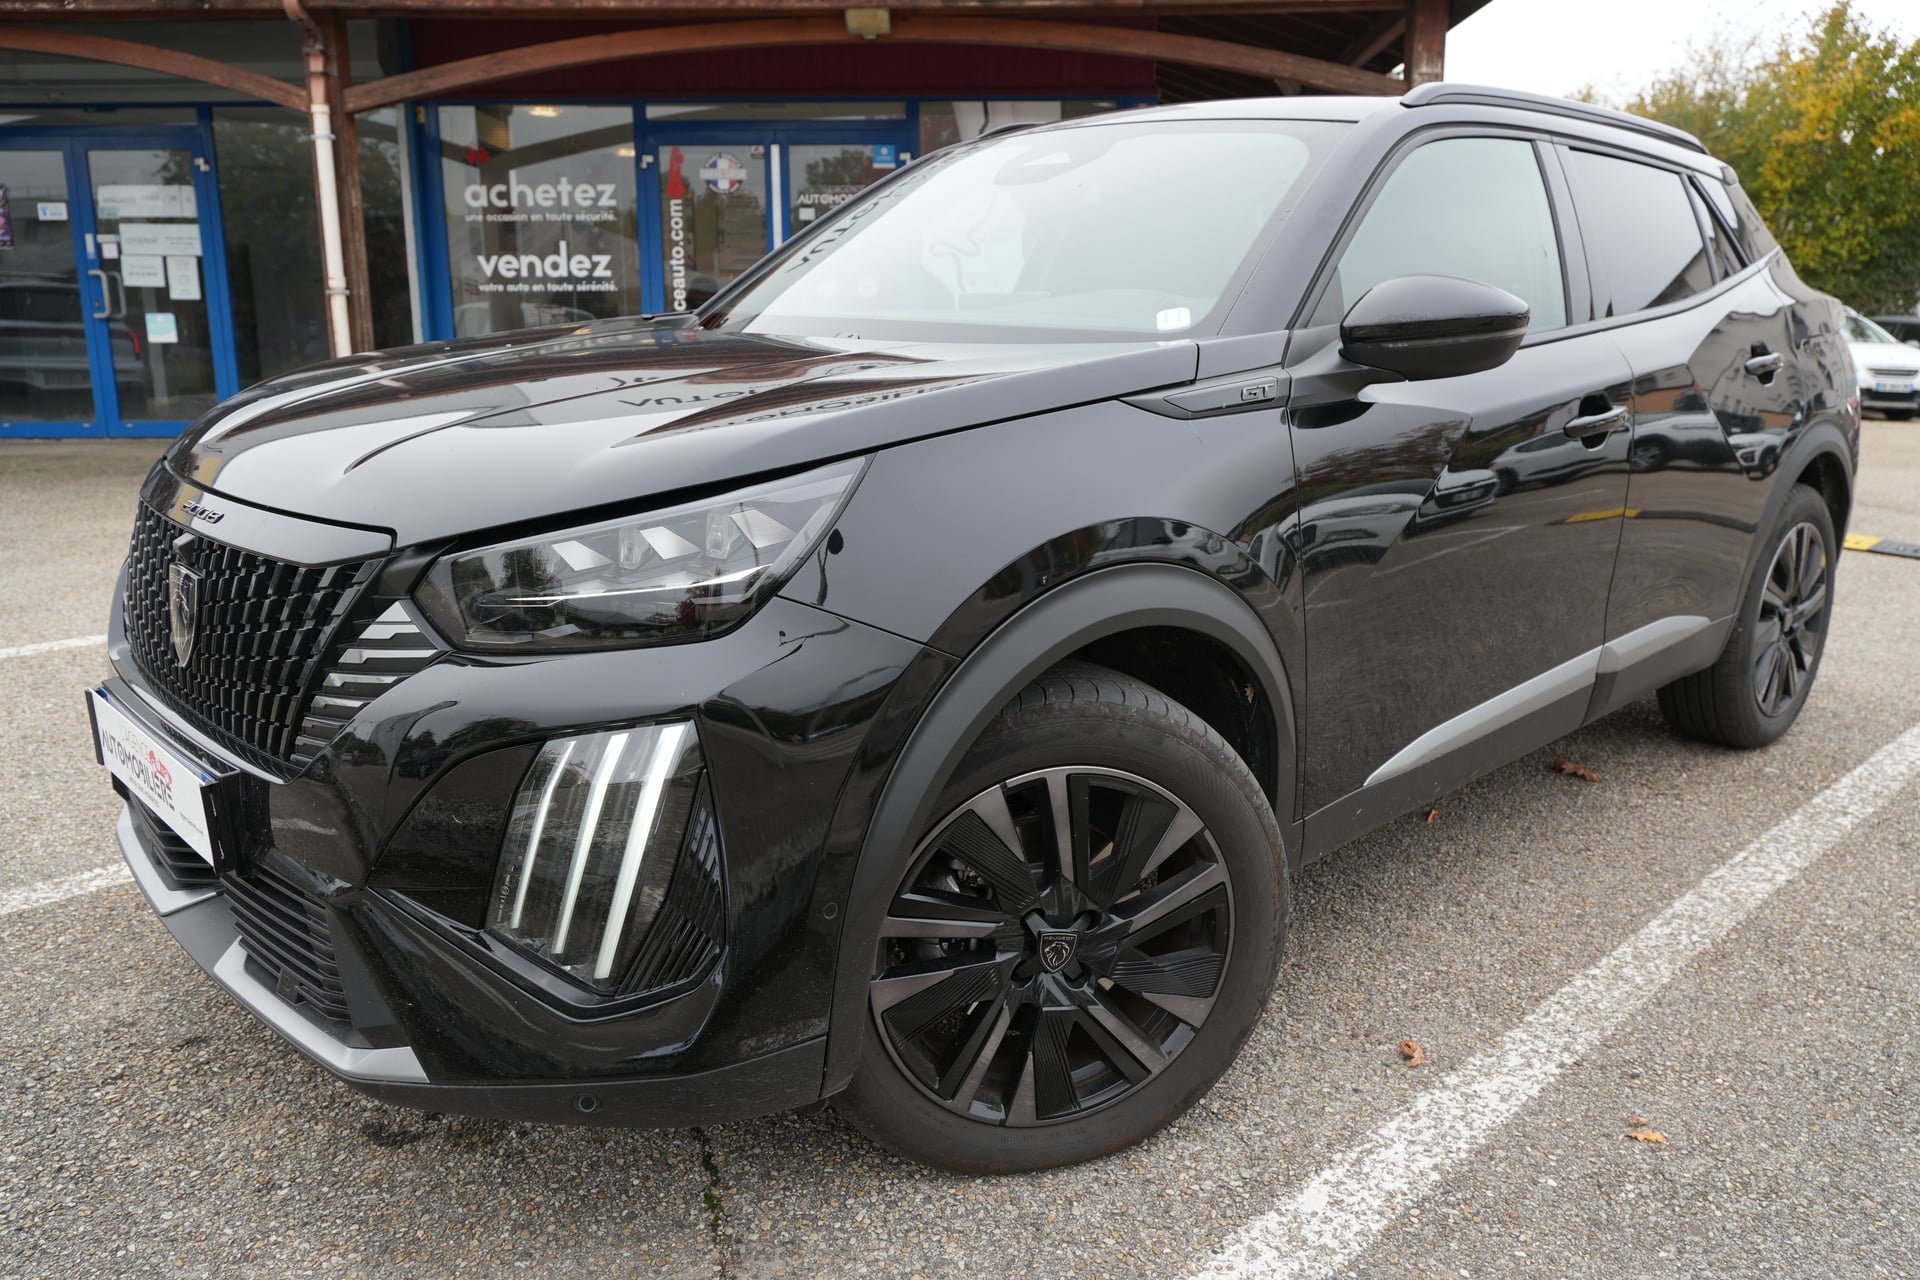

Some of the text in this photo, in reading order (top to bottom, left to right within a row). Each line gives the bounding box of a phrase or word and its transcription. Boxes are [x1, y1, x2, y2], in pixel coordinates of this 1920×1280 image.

[464, 169, 617, 208] achetez
[465, 209, 617, 222] une occasion en toute sécurité.
[477, 239, 612, 279] vendez
[478, 280, 618, 292] votre auto en toute sérénité.
[1241, 383, 1274, 401] GT
[181, 500, 225, 525] 2008
